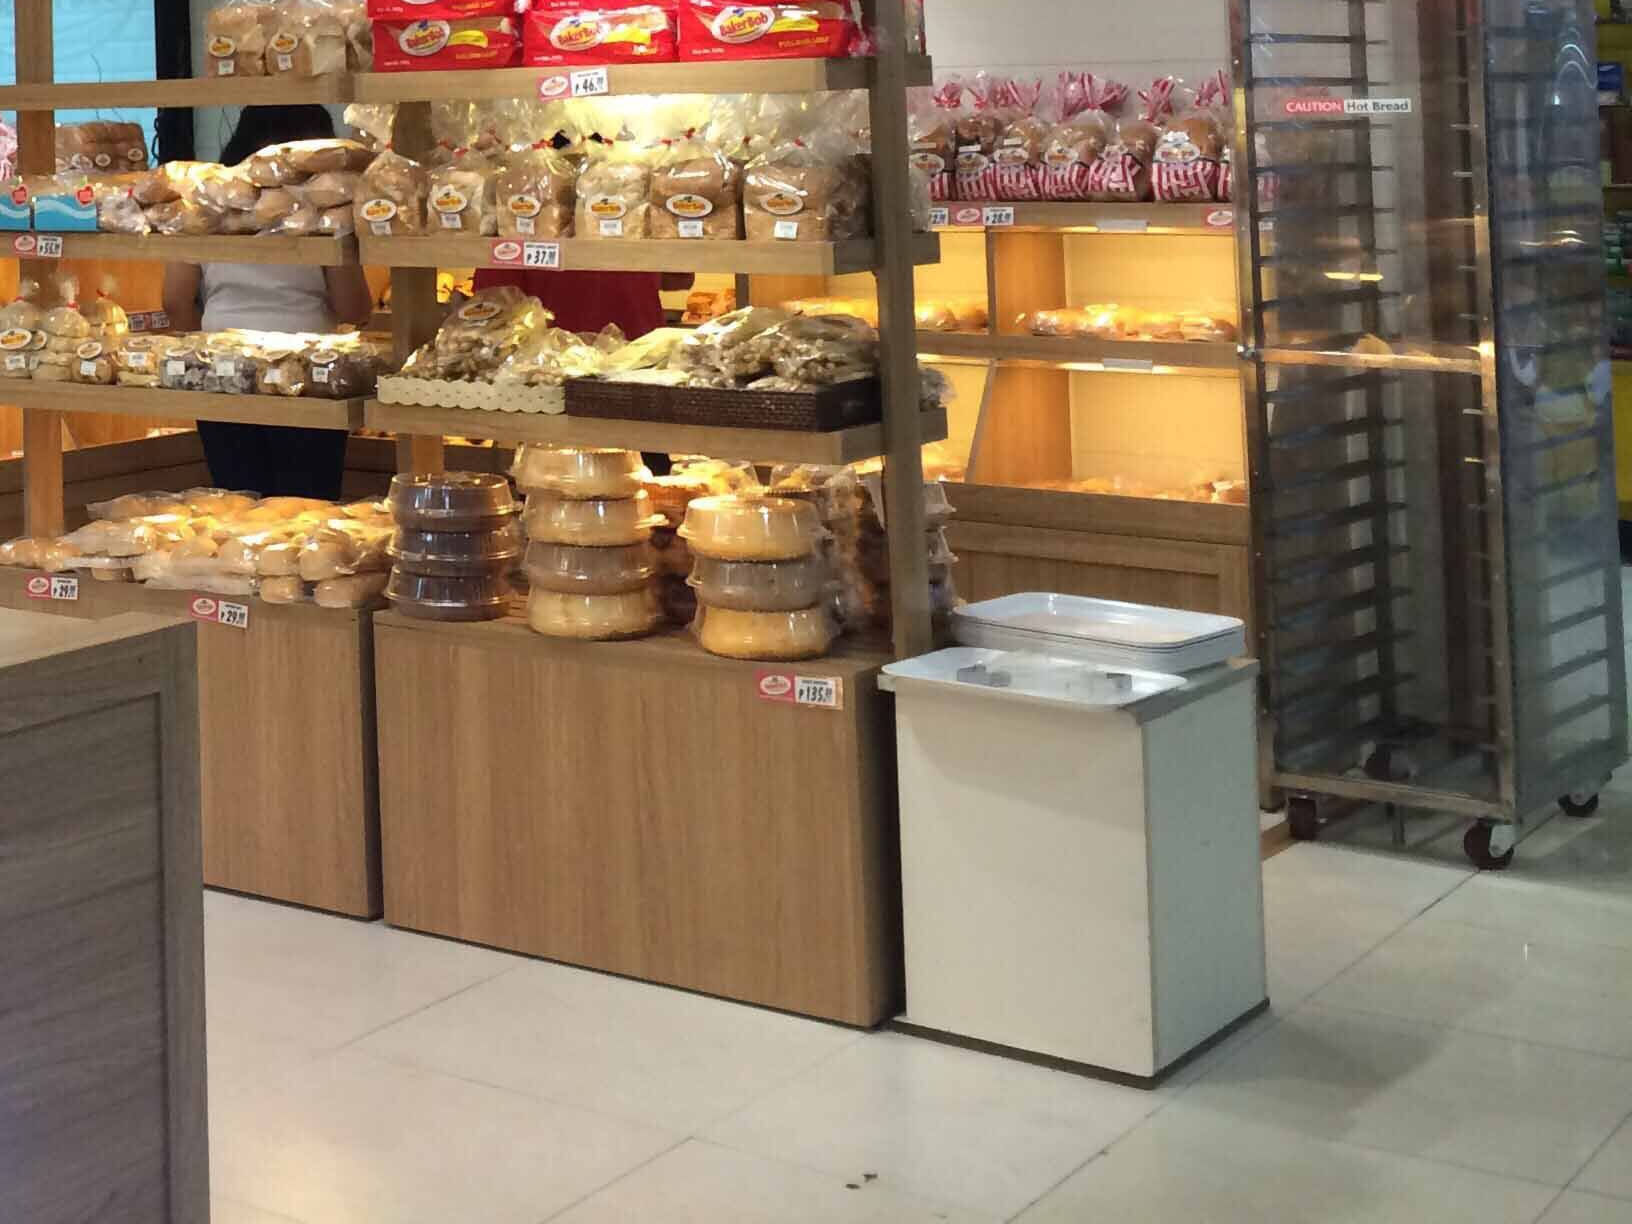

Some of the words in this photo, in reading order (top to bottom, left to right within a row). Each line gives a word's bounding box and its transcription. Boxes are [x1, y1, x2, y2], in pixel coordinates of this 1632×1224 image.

[1286, 101, 1342, 113] CAUTION
[1348, 101, 1369, 112] Hot
[1372, 101, 1409, 112] Bread
